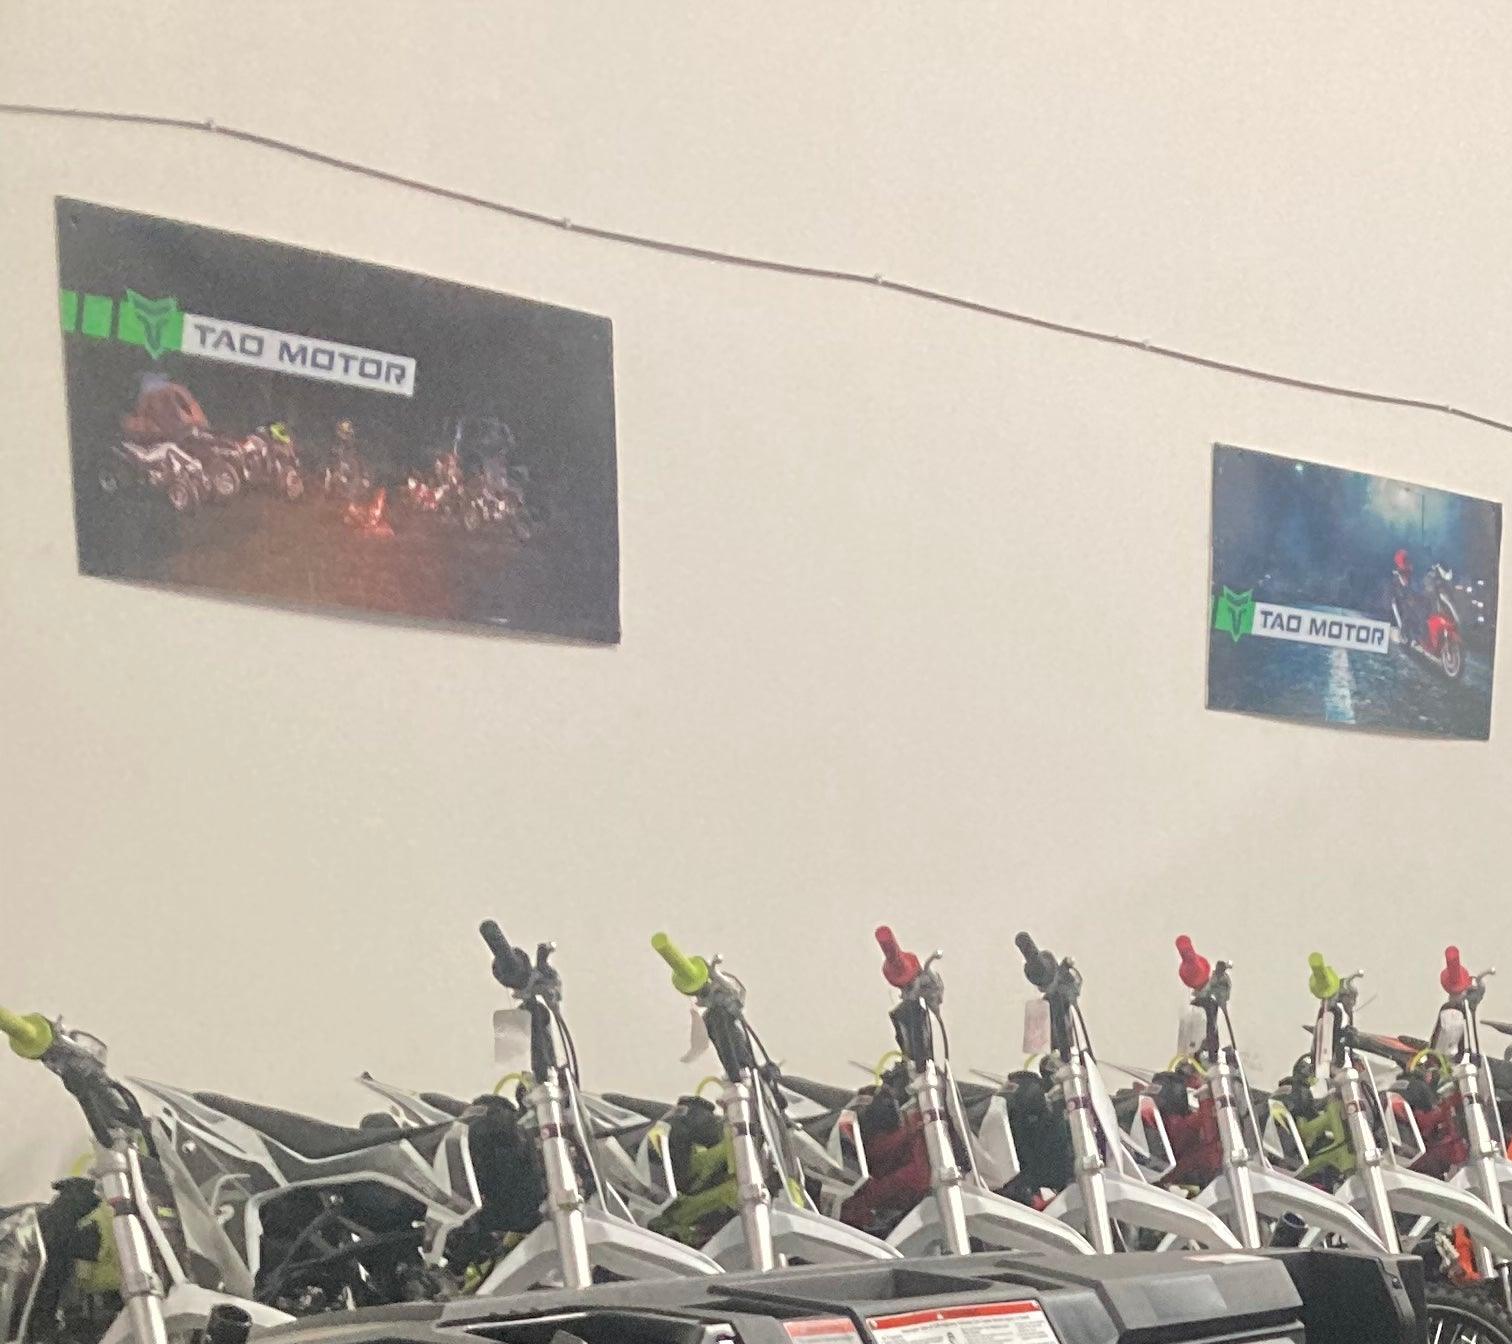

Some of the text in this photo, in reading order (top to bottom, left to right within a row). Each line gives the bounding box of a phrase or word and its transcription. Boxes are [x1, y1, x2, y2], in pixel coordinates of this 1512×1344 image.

[194, 323, 406, 385] TAO MOTOR
[1261, 610, 1385, 646] TAO MOTOR
